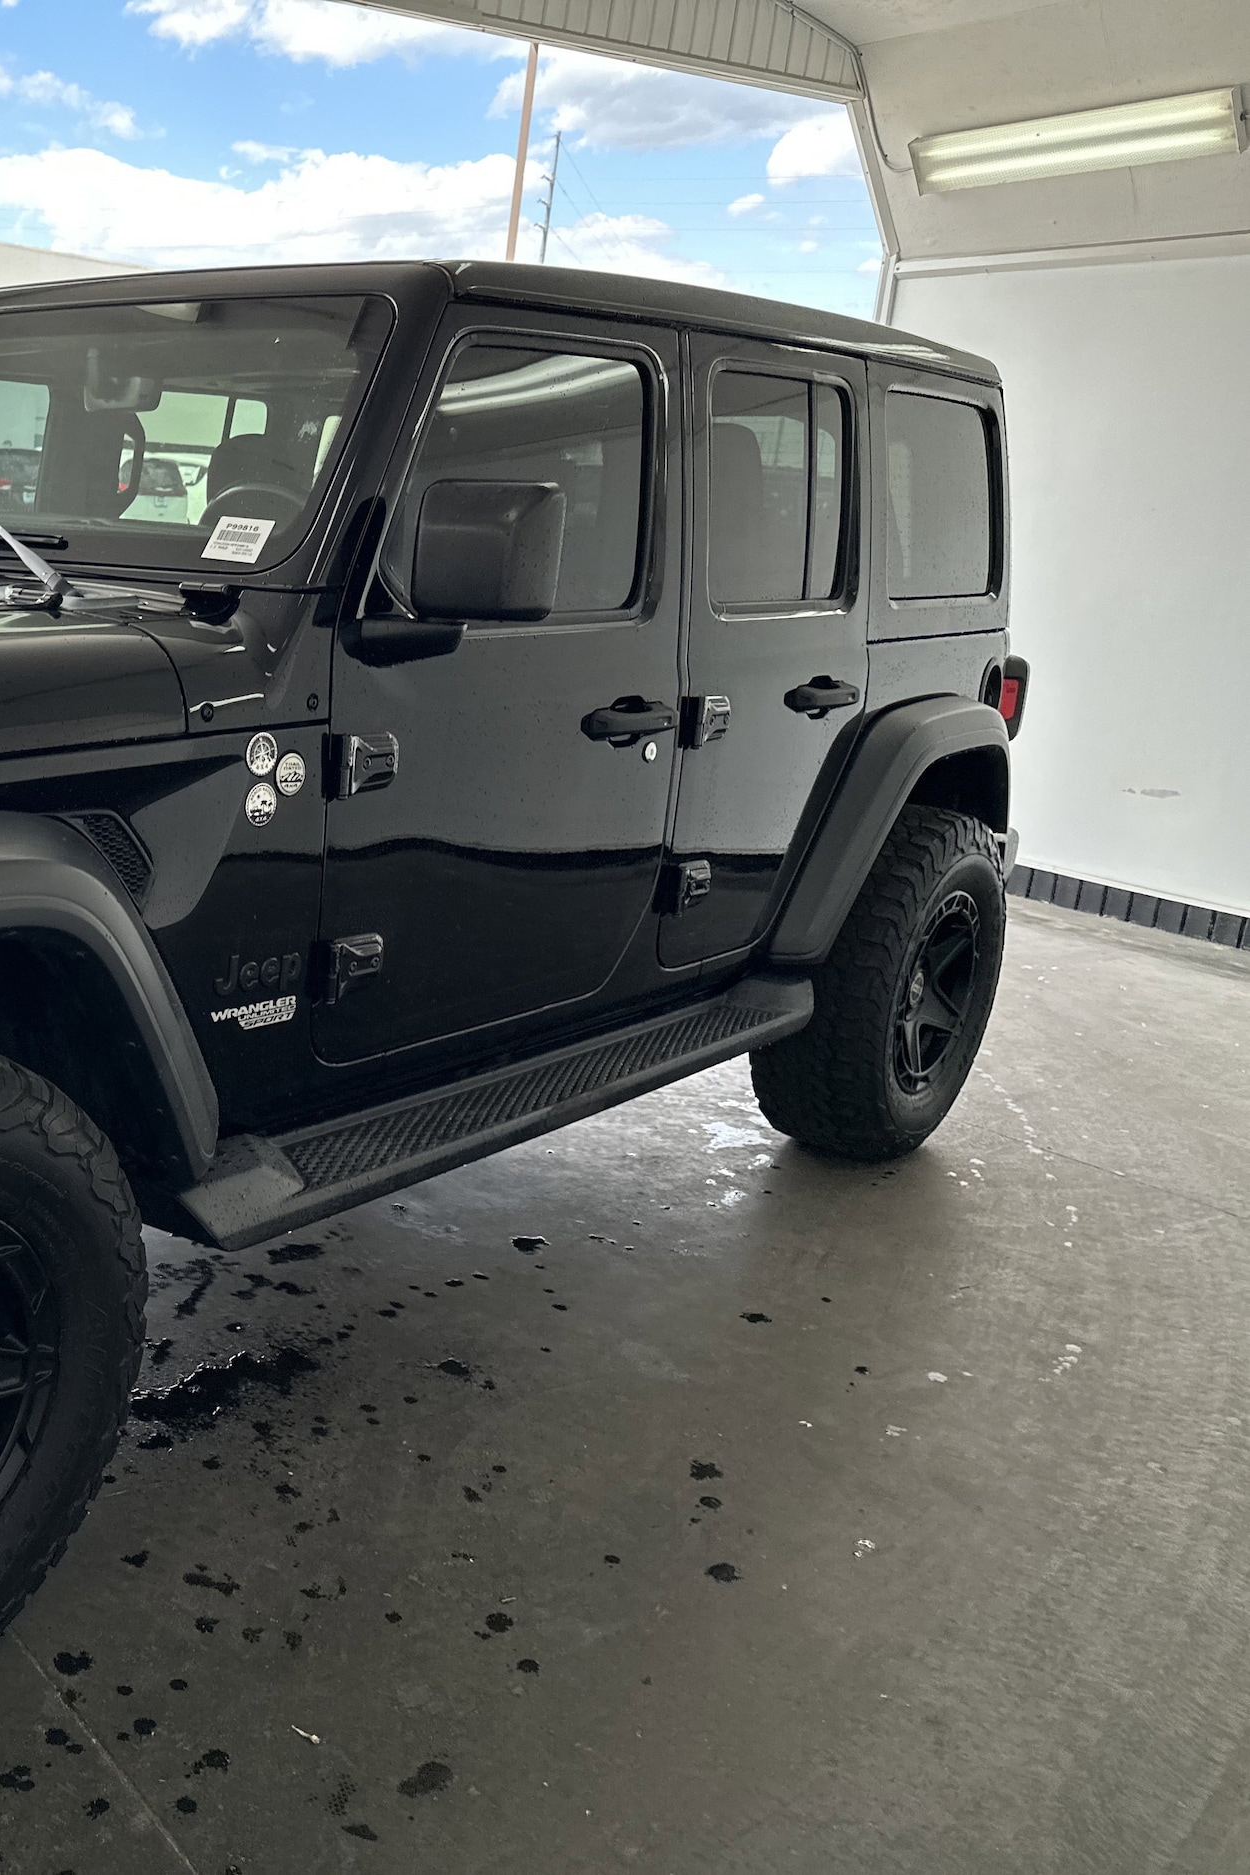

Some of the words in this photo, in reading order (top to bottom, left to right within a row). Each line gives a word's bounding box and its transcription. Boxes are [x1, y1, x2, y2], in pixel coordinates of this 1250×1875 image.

[214, 952, 302, 995] Jeep
[211, 995, 297, 1022] WRANGLER
[237, 1004, 297, 1021] UNLIMITED
